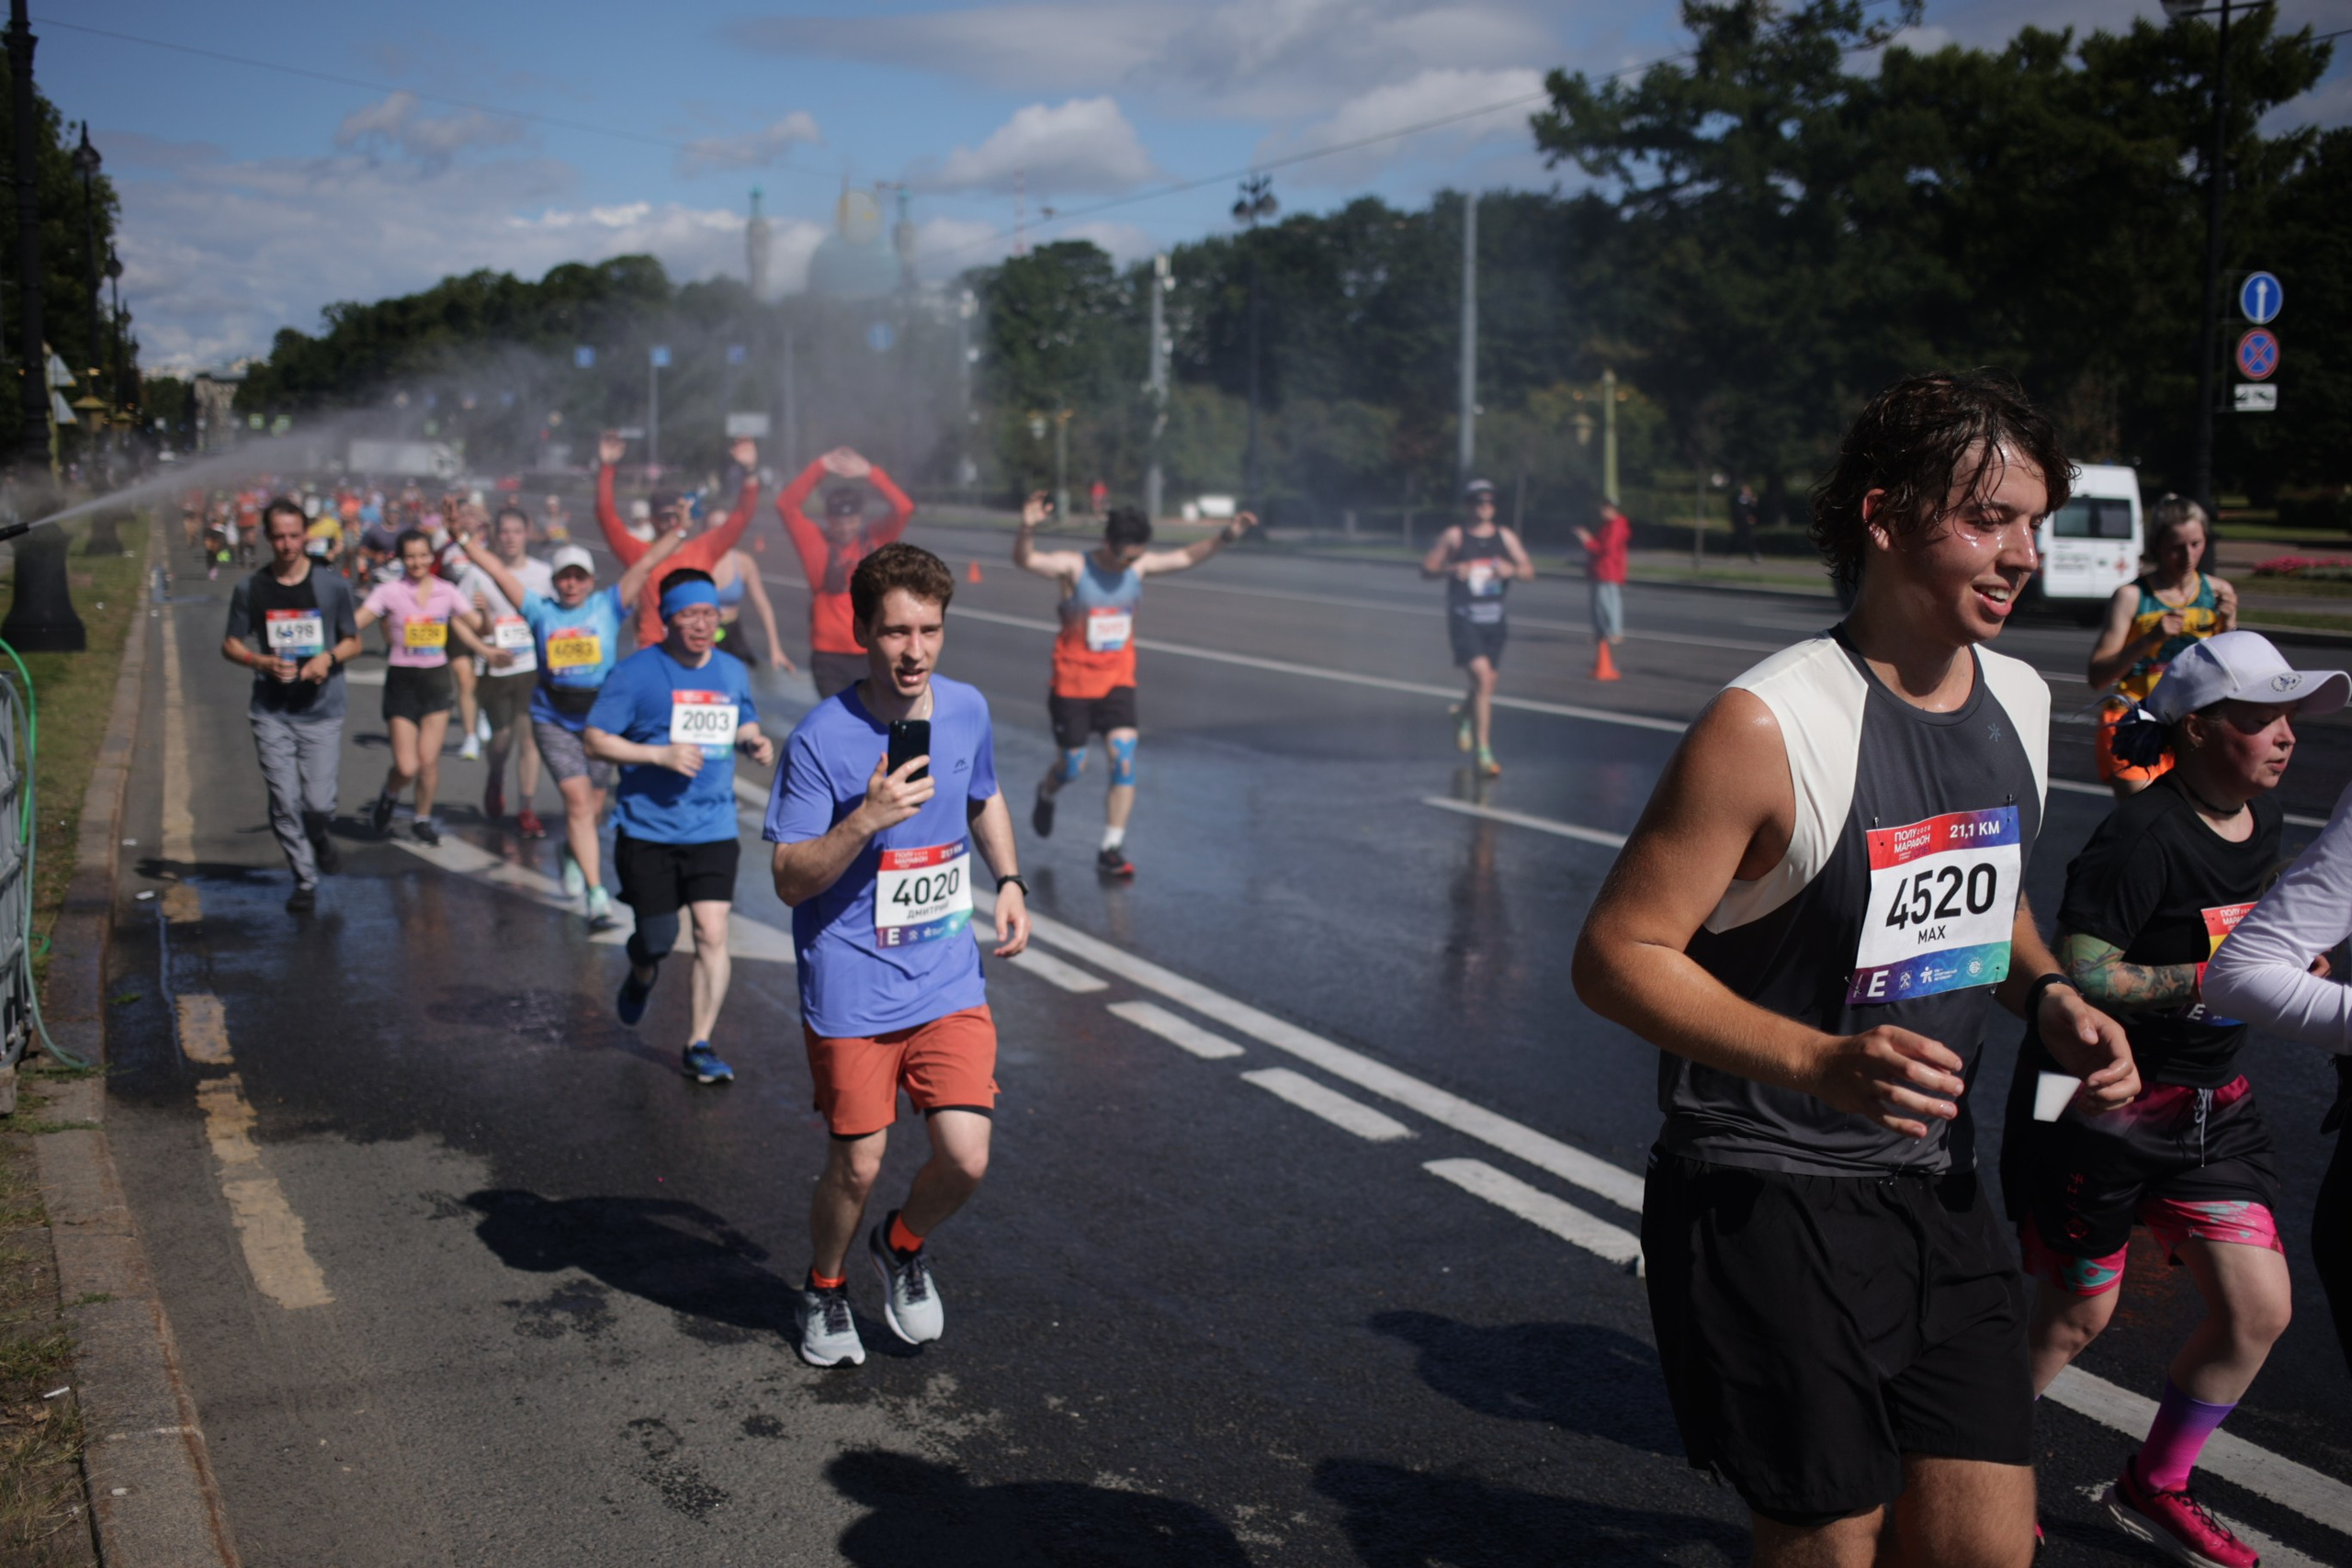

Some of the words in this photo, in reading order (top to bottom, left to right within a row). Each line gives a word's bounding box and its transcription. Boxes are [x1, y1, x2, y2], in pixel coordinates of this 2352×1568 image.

[683, 710, 729, 732] 2003
[1894, 828, 1917, 842] ПОЛУ
[1950, 823, 1974, 840] 21,1
[1894, 833, 1931, 853] МАРАФОН
[892, 867, 959, 907] 4020
[1885, 863, 1997, 931] 4520
[907, 900, 949, 920] ДМИТРИЙ
[2220, 908, 2240, 917] ПОЛУ
[887, 928, 900, 946] E
[1917, 925, 1946, 944] MAX
[1867, 969, 1890, 998] E
[2188, 1003, 2206, 1021] E
